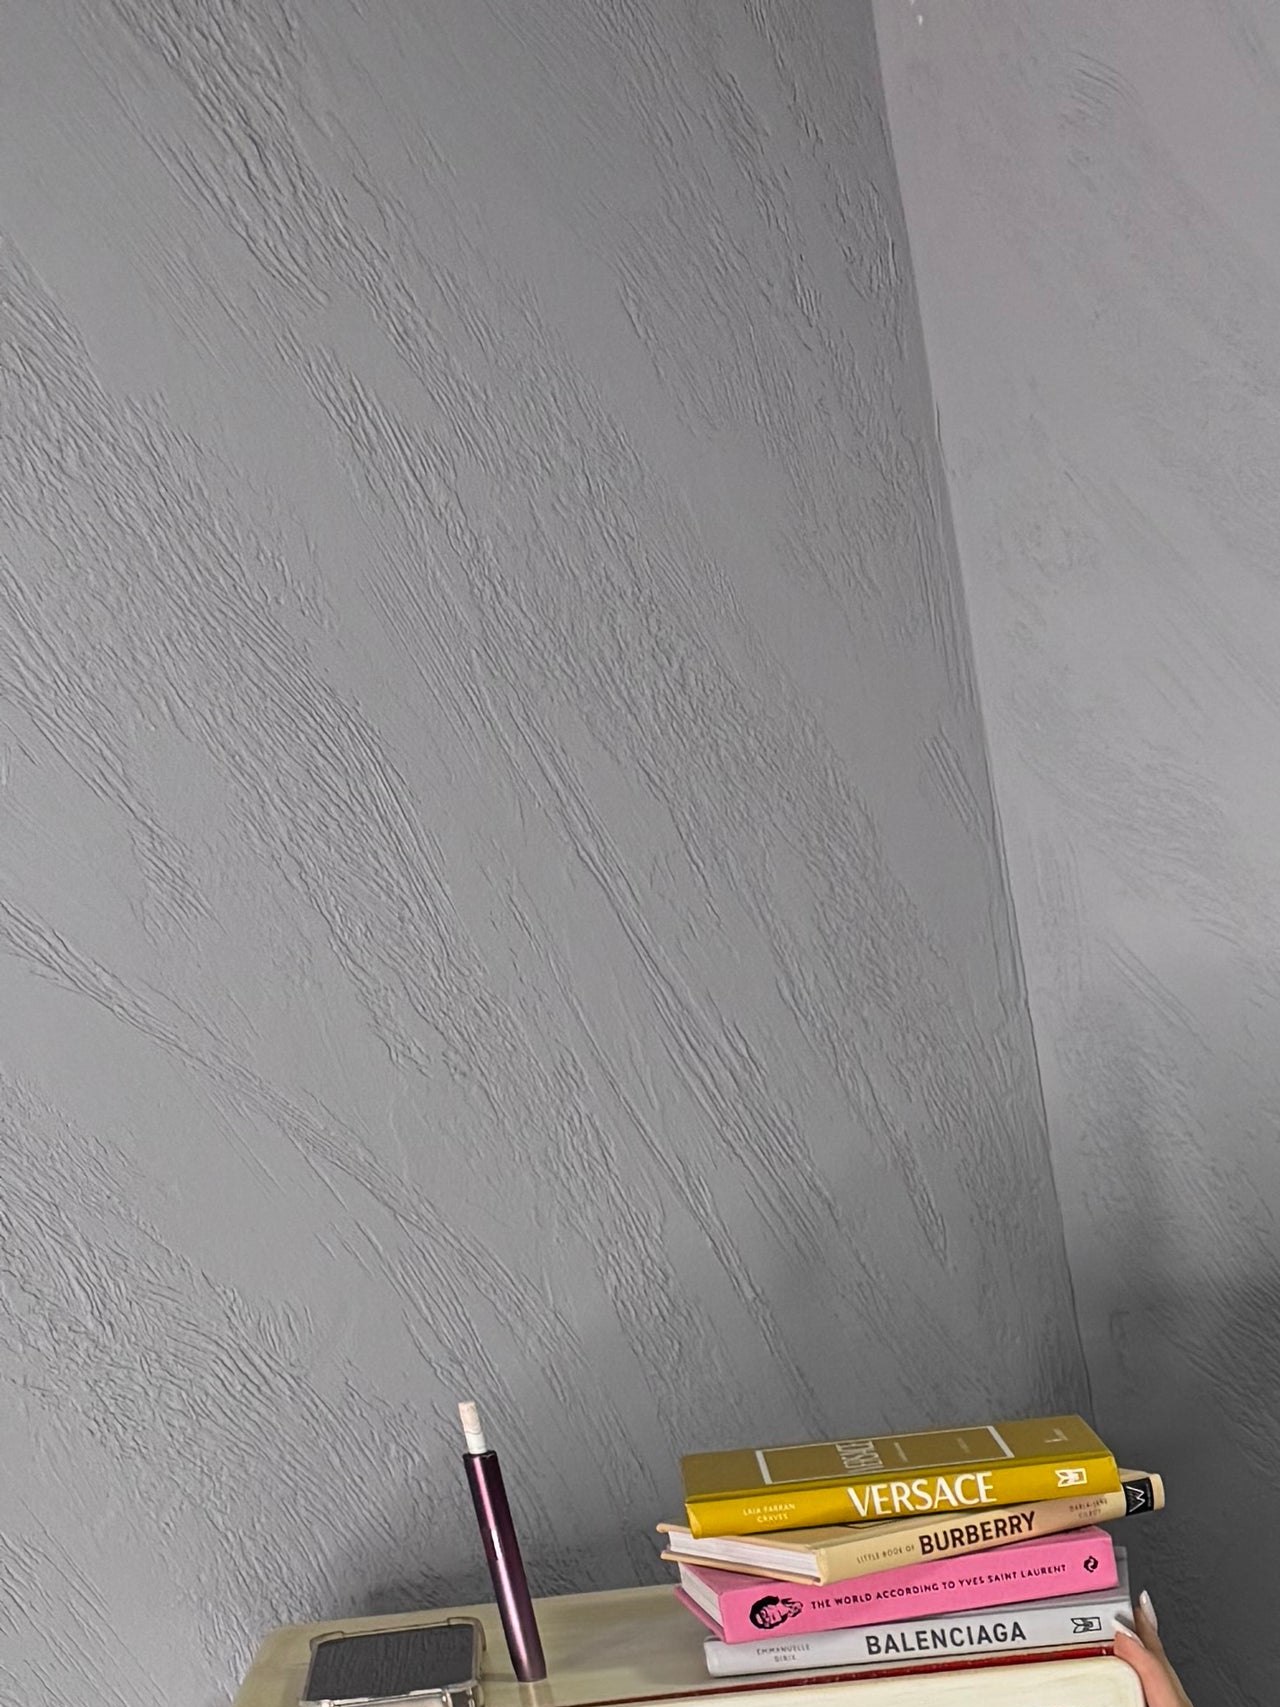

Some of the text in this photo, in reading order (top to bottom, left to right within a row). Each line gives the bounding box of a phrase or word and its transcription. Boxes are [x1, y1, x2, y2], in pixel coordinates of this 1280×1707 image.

[847, 1470, 998, 1518] VERSACE
[918, 1511, 1035, 1556] BURBERRY
[810, 1564, 1067, 1612] THE WORLD ACCORDING TO YVES SAINT LAURENT
[865, 1621, 1027, 1656] BALENCIAGA
